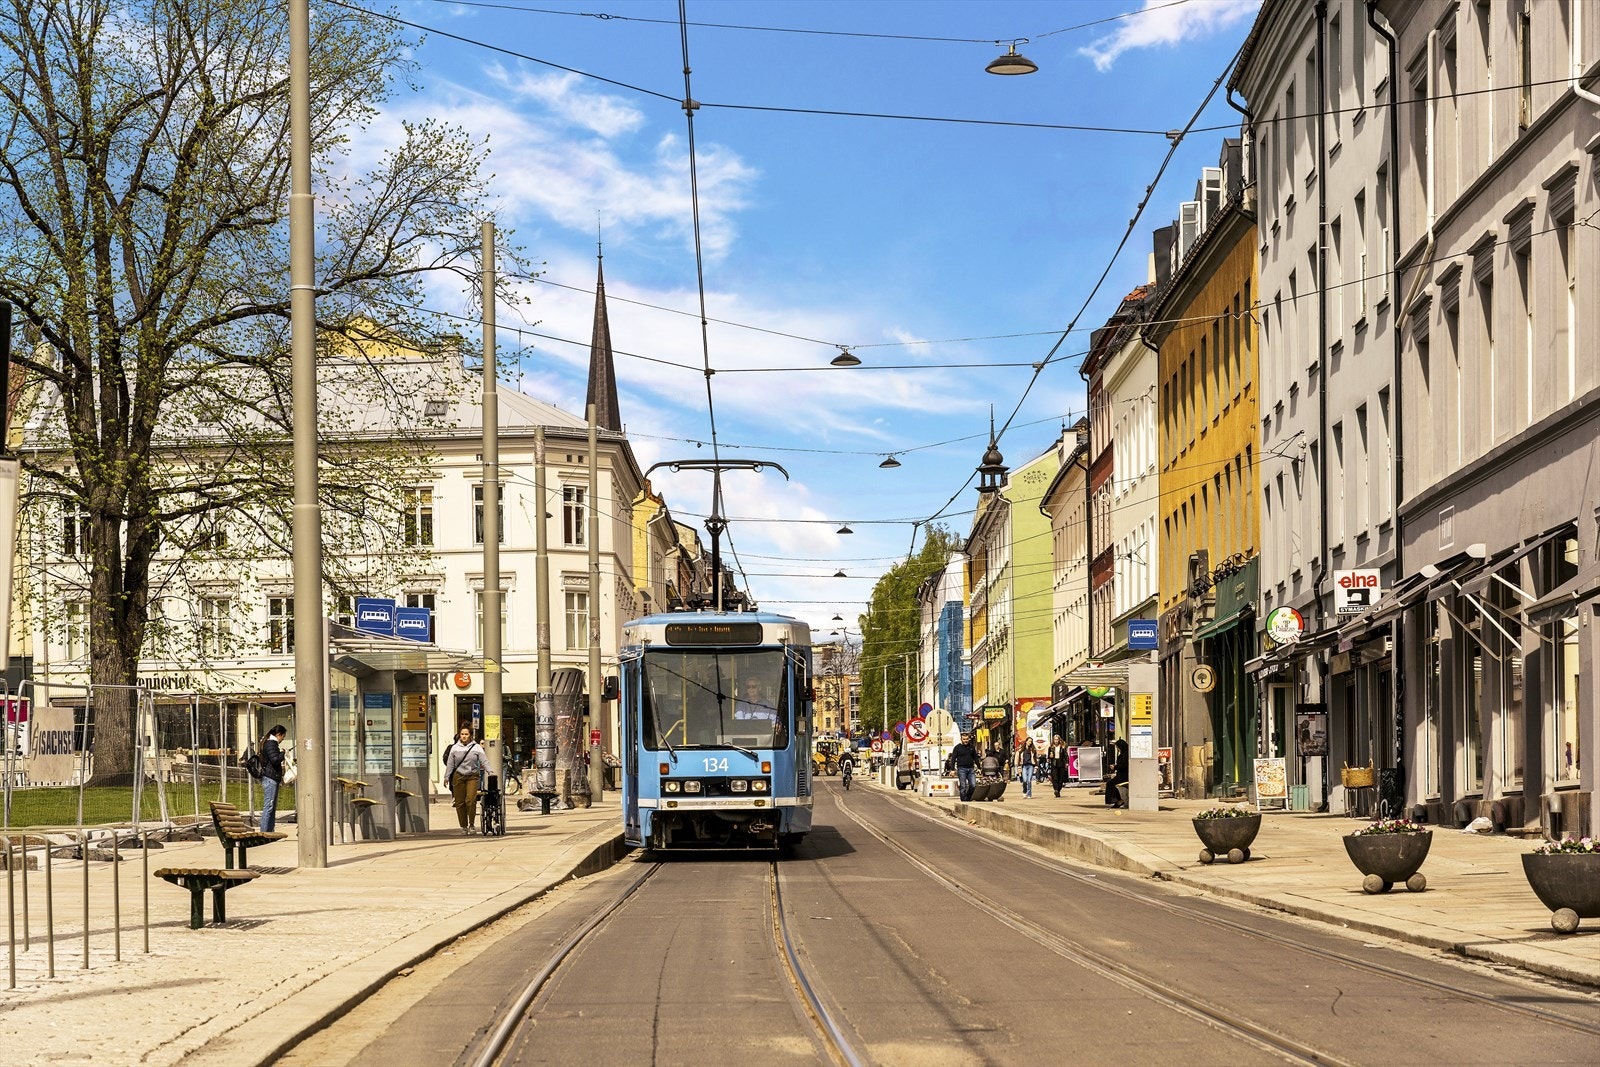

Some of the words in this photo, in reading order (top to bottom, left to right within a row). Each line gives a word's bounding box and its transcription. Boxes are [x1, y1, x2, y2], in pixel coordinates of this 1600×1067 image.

[1338, 572, 1377, 588] elna
[136, 673, 190, 691] enneriet
[702, 757, 728, 772] 134
